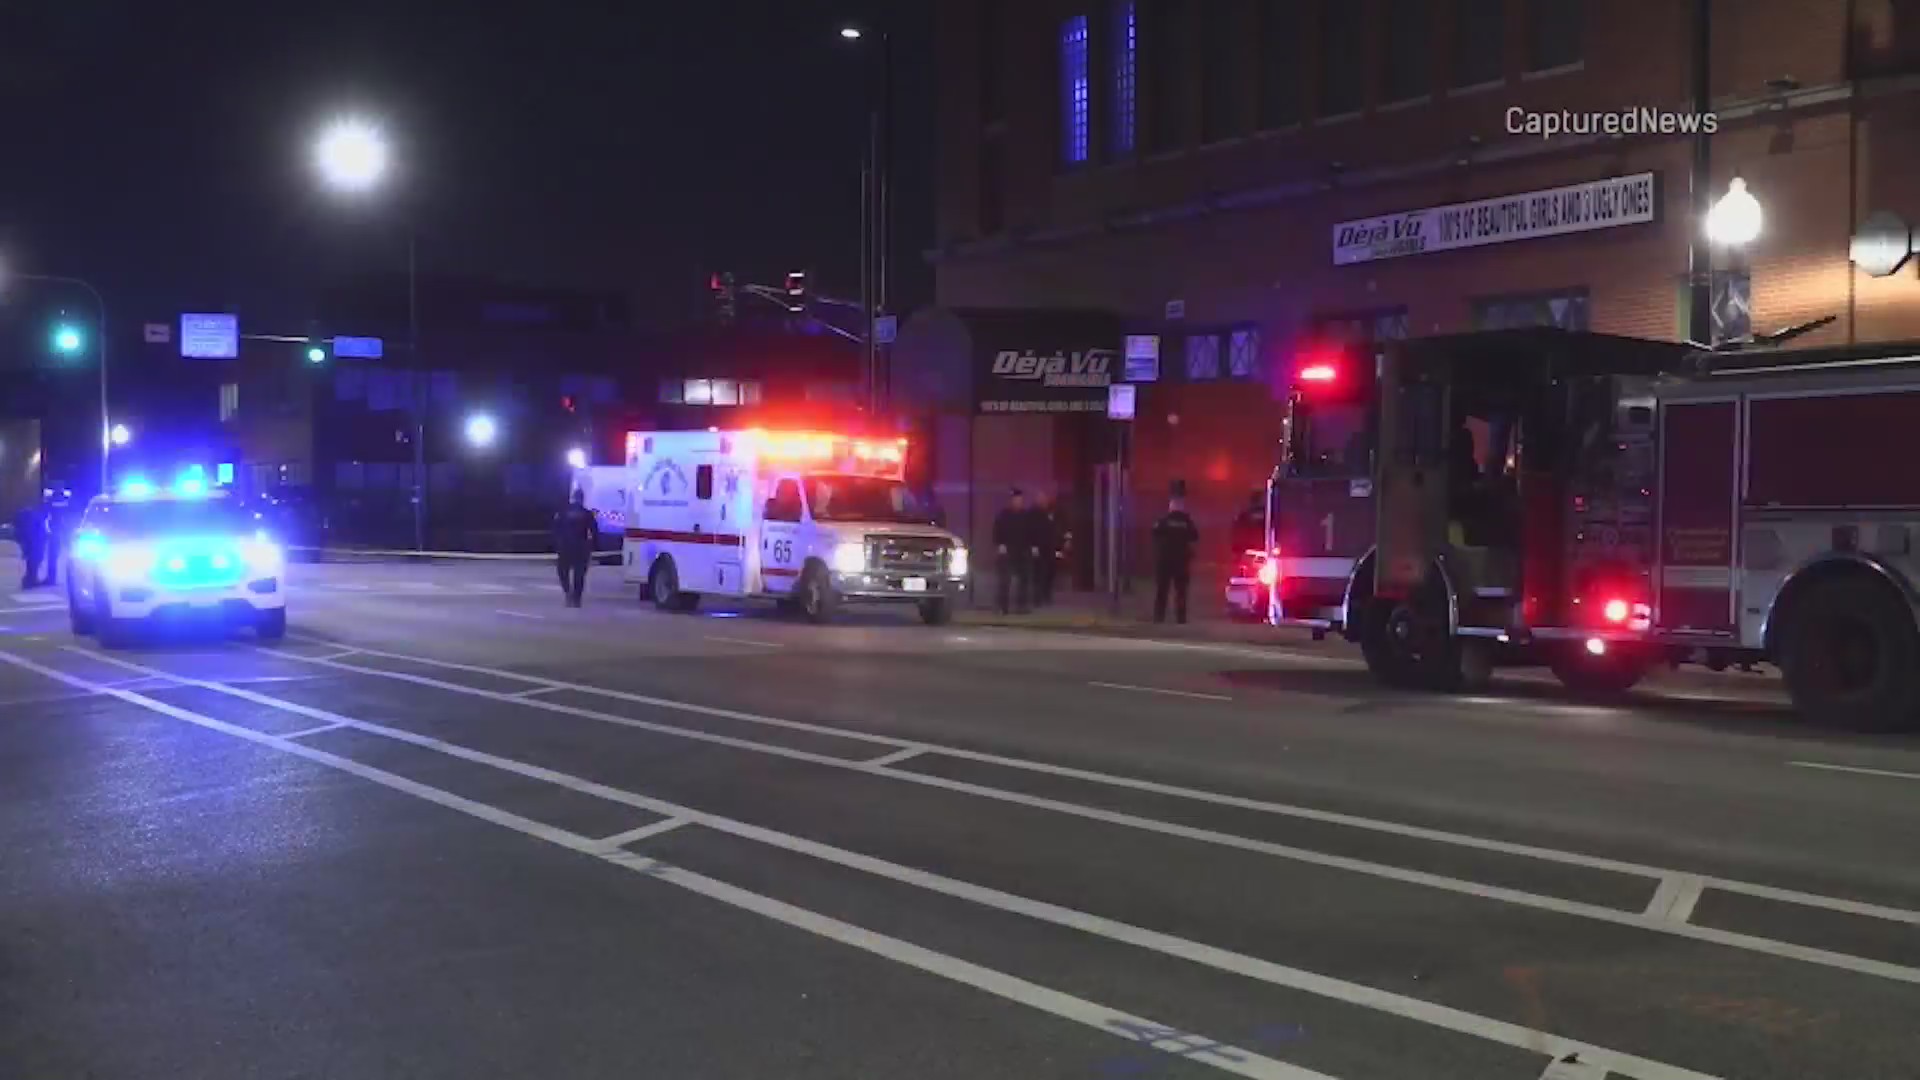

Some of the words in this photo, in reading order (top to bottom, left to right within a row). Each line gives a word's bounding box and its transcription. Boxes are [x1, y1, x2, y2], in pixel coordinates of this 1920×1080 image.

[1478, 199, 1527, 237] BEAUTIFUL
[1531, 193, 1559, 229] GIRLS
[1562, 190, 1581, 224] AND
[1592, 184, 1620, 221] UGLY
[1623, 179, 1649, 217] ONES
[1393, 213, 1427, 240] Vu
[1070, 348, 1113, 374] Vu
[773, 539, 793, 564] 65
